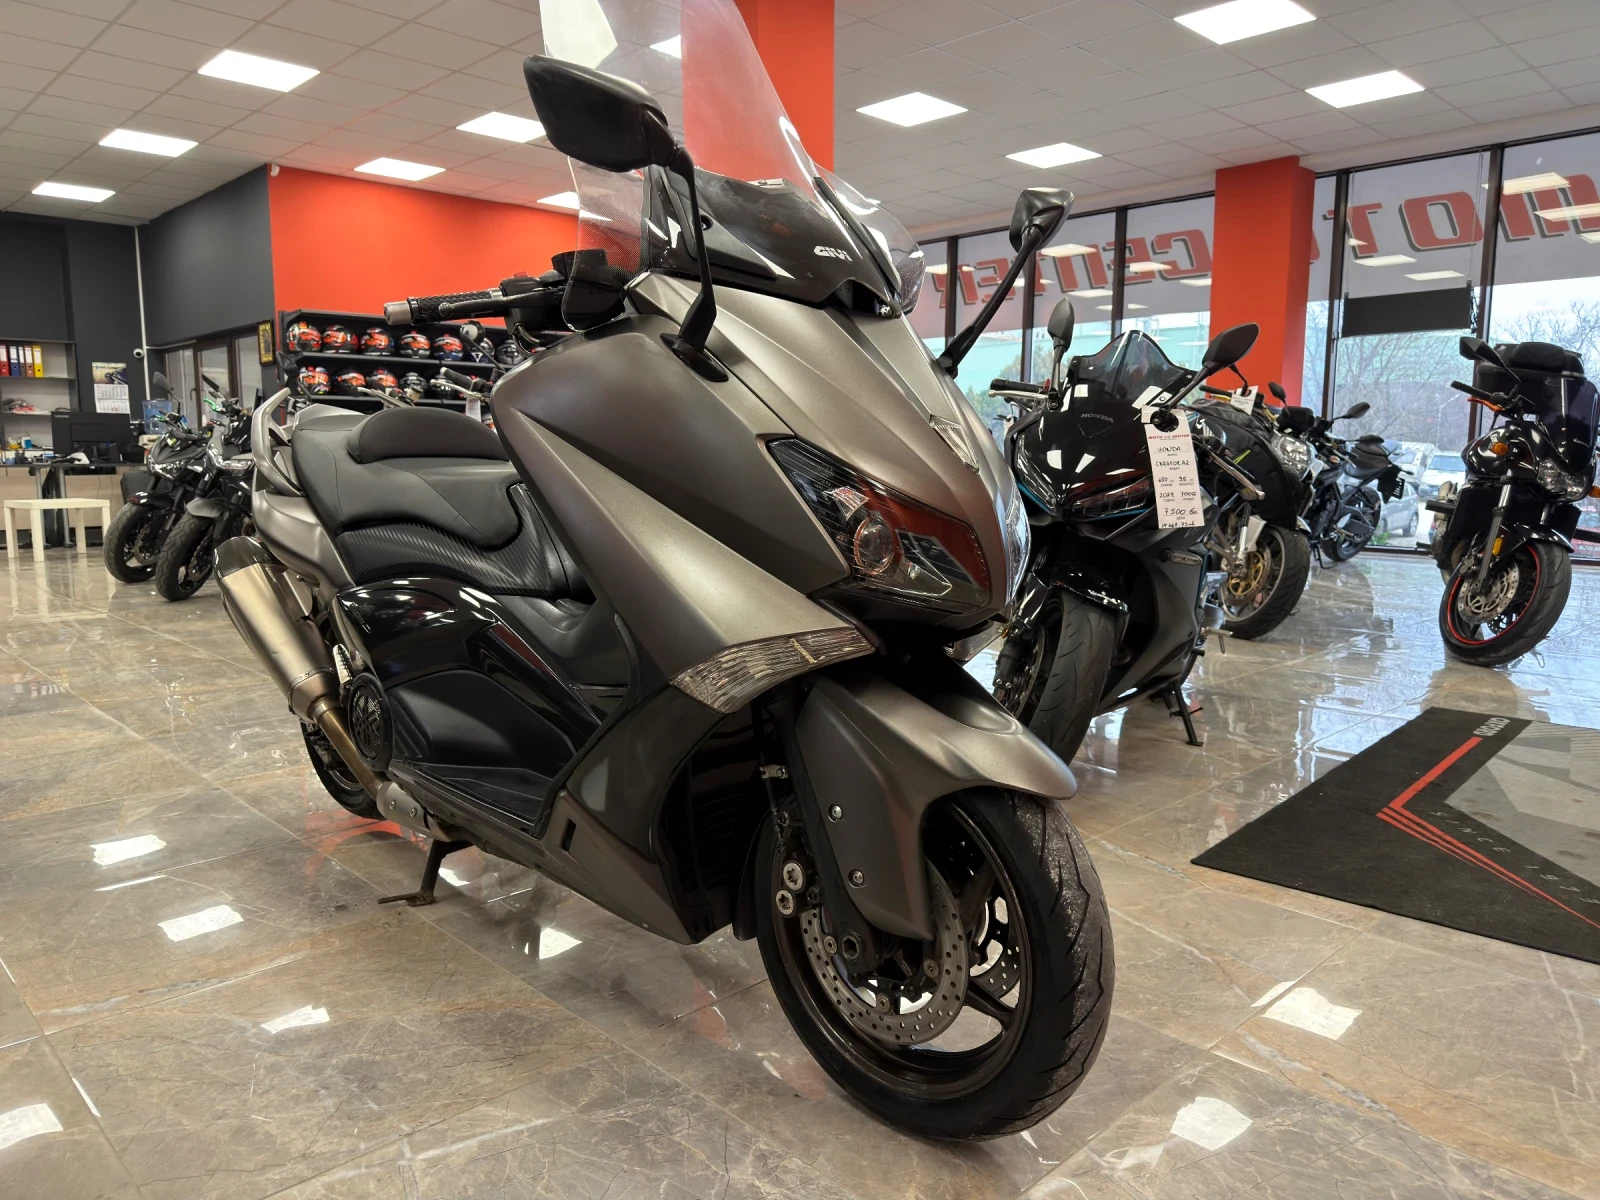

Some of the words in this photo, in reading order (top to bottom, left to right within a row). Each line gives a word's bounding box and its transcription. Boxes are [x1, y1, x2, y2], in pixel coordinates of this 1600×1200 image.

[814, 245, 853, 262] GIVI
[1080, 413, 1115, 424] HONDA
[1430, 811, 1511, 853] SINCE
